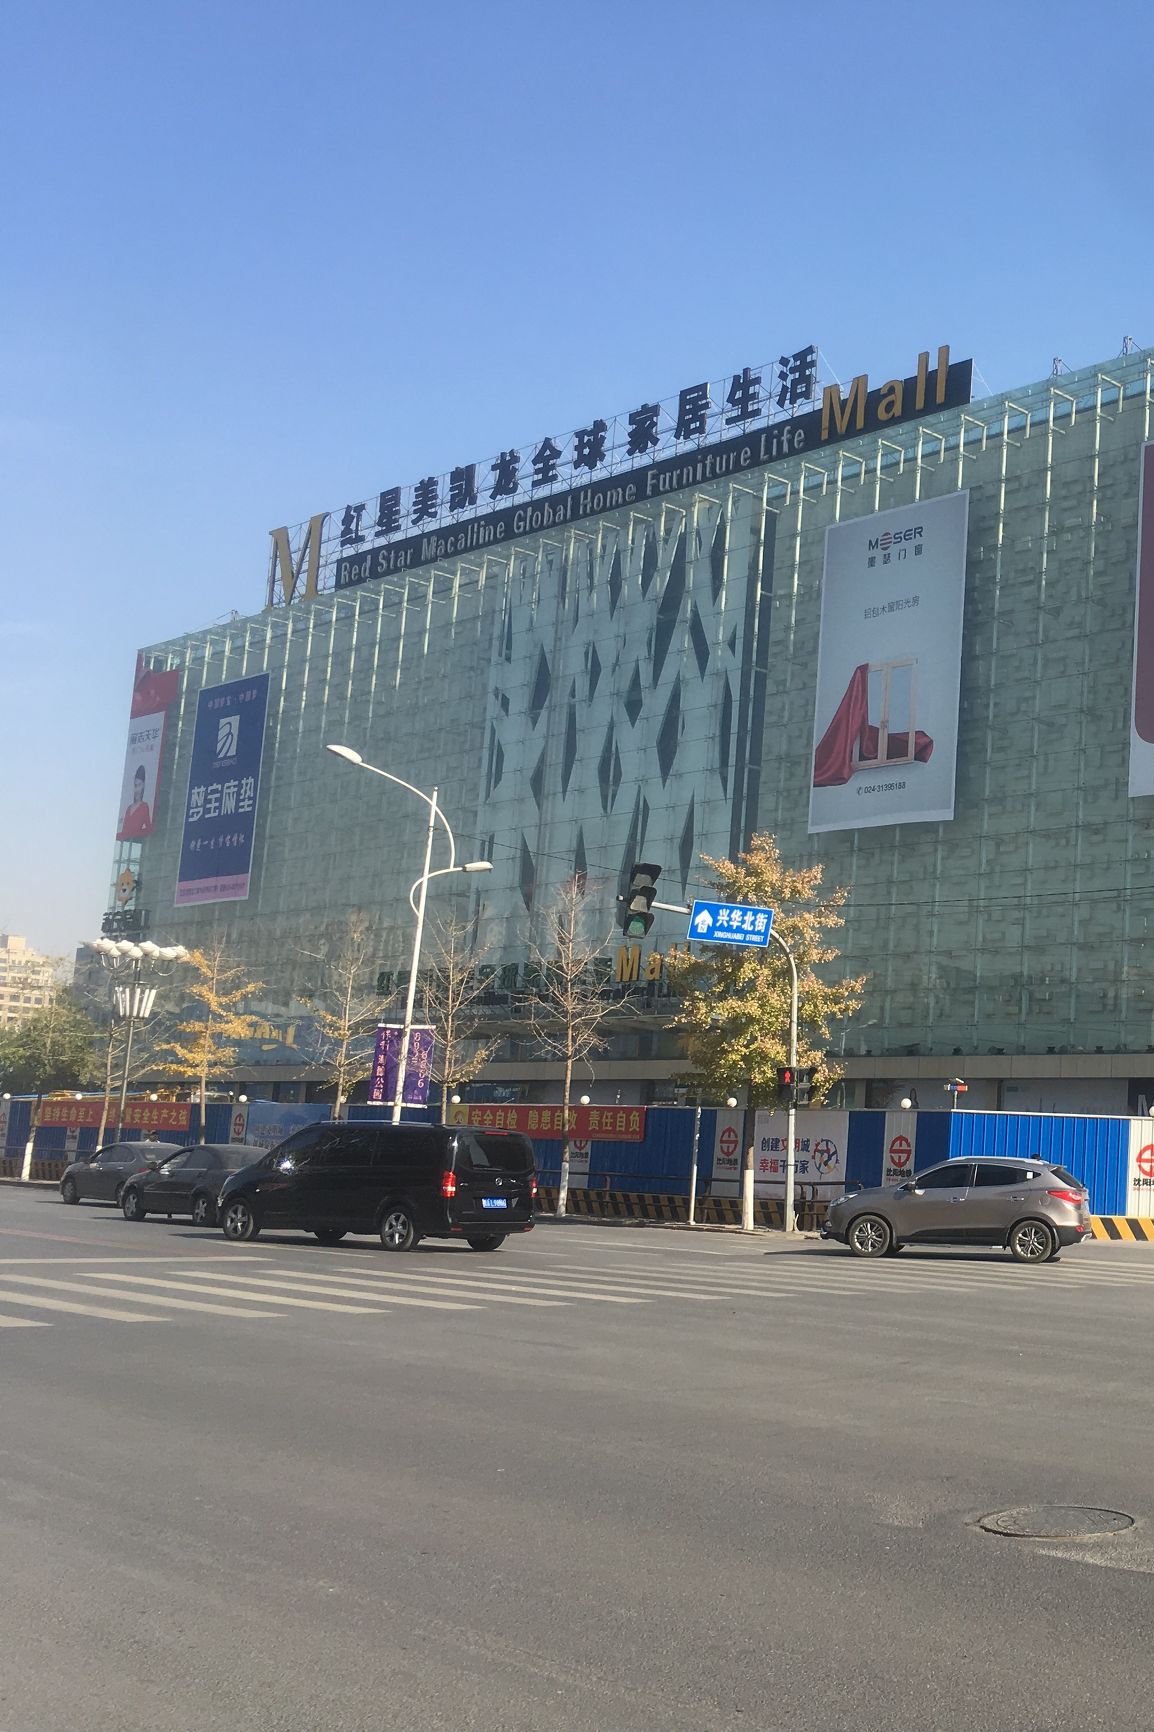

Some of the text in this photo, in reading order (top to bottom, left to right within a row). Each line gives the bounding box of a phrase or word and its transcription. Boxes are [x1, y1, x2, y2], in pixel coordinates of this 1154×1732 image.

[340, 345, 949, 547] 红星美凯龙全球家居生活 Mall
[340, 555, 371, 585] Red
[378, 548, 412, 574] Star
[514, 496, 572, 531] Global
[579, 482, 637, 515] Home
[647, 445, 751, 496] Furniture
[760, 425, 806, 462] Life
[268, 511, 331, 609] M
[188, 776, 254, 822] 梦宝床垫
[716, 908, 769, 932] 兴华北街
[746, 933, 765, 943] STREET
[471, 1109, 517, 1129] 安全自检
[588, 1111, 641, 1131] 责任自负
